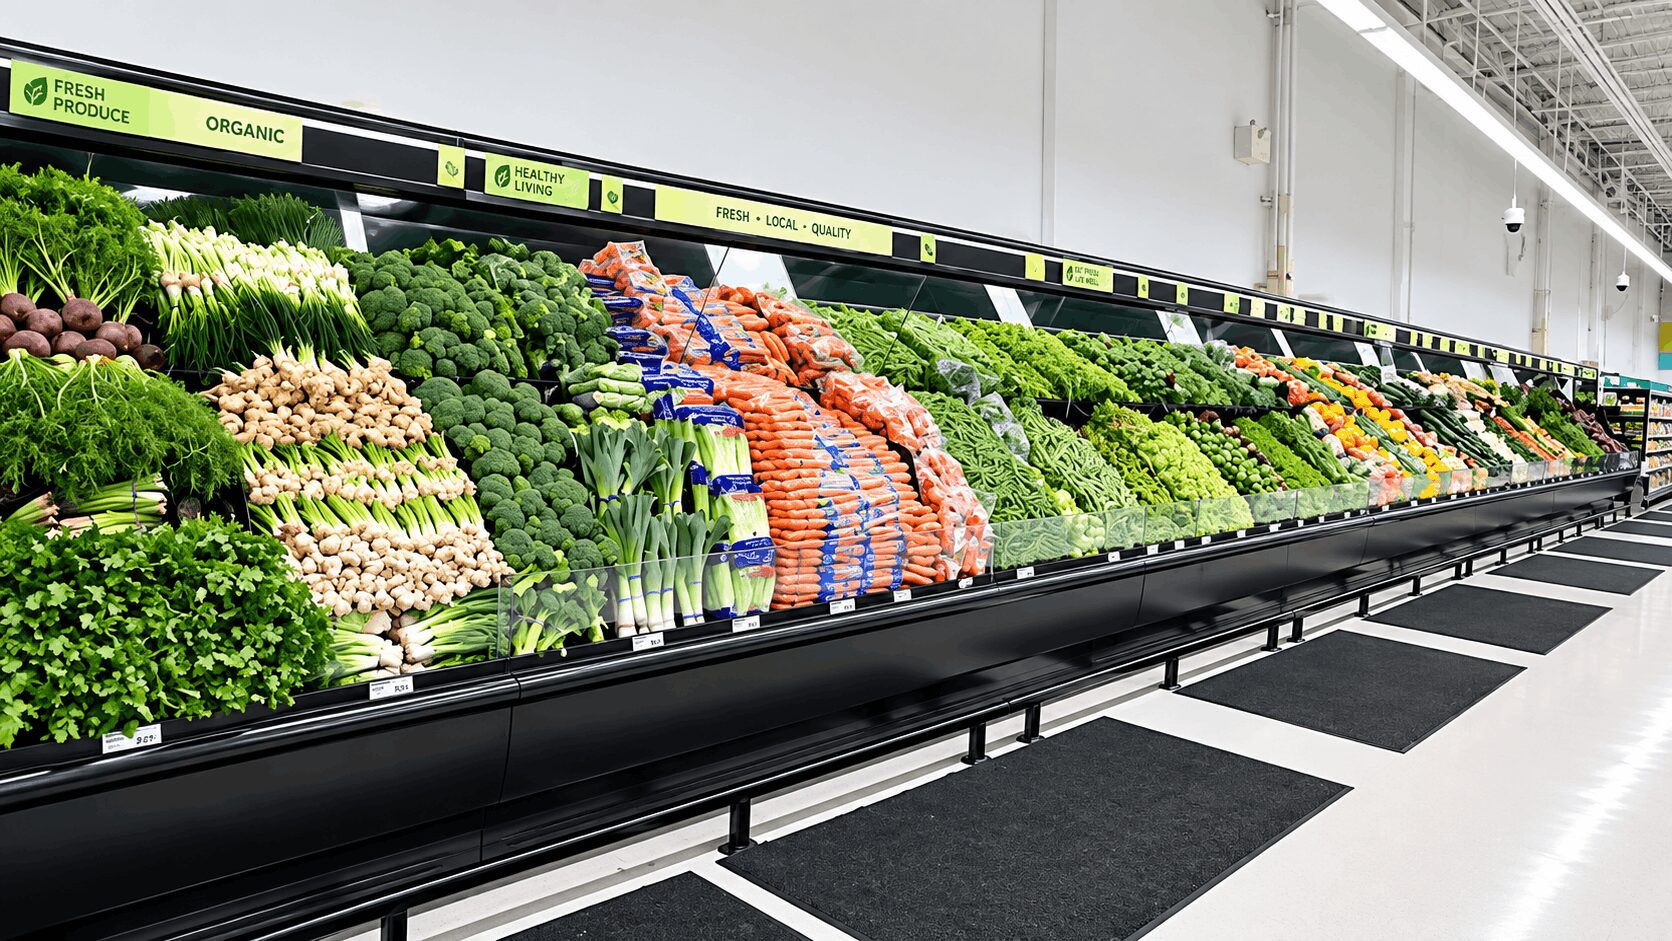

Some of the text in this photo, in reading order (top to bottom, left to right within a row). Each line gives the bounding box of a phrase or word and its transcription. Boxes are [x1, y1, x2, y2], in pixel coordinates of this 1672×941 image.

[54, 78, 105, 102] FRESH
[53, 96, 130, 125] PRODUCE
[205, 116, 285, 144] ORGANIC
[514, 165, 566, 185] HEALTHY
[514, 179, 553, 197] LIVING
[716, 206, 852, 240] FRESH LOCAL QUALITY
